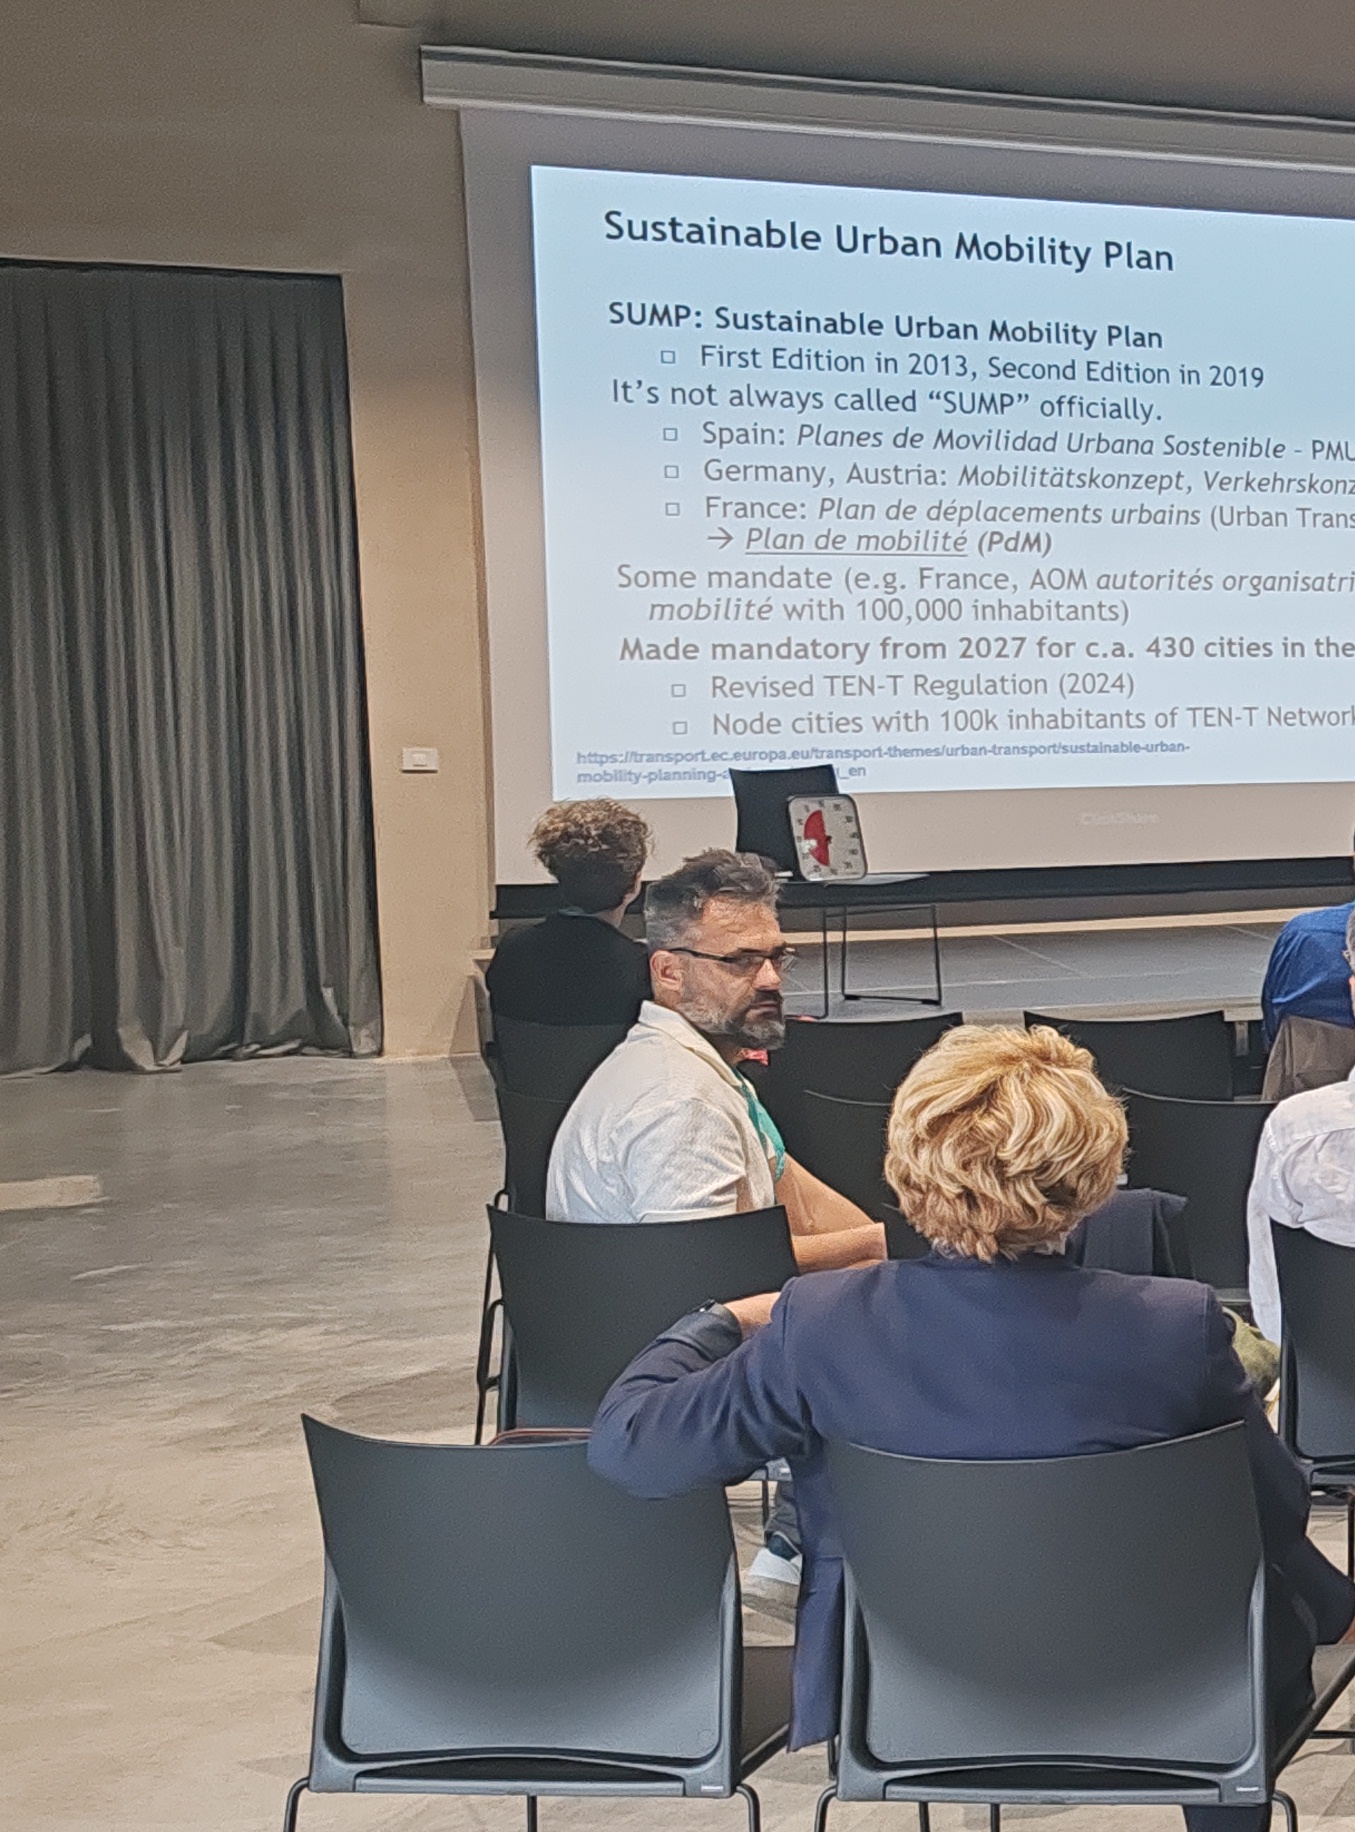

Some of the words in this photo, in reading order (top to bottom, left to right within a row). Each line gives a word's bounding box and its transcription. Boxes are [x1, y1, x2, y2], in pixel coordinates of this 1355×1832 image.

[604, 210, 822, 251] Sustainable
[836, 224, 942, 258] Urban
[955, 231, 1092, 274] Mobility
[1104, 240, 1174, 272] Plan
[608, 301, 702, 329] SUMP:
[714, 306, 884, 337] Sustainable
[895, 314, 979, 341] Urban
[988, 319, 1098, 351] Mobility
[1107, 324, 1163, 349] Plan
[701, 344, 763, 369] First
[772, 347, 865, 373] Edition
[874, 351, 898, 374] in
[908, 352, 977, 382] 2013,
[988, 356, 1076, 381] Second
[1086, 360, 1170, 384] Edition
[1178, 361, 1201, 385] in
[1209, 365, 1264, 389] 2019
[671, 383, 719, 407] not
[728, 383, 824, 415] always
[833, 387, 917, 413] called
[1039, 394, 1162, 426] officially.
[702, 420, 785, 450] Spain:
[797, 423, 884, 448] Planes
[892, 426, 925, 449] de
[932, 428, 1058, 453] Movilidad
[1066, 432, 1154, 456] Urbana
[1162, 434, 1286, 459] Sostenible
[703, 458, 835, 489] Germany,
[845, 462, 947, 487] Austria:
[957, 464, 1192, 496] Mobilitätskonzept,
[705, 495, 807, 520] France:
[818, 496, 876, 521] Plan
[885, 498, 918, 521] de
[926, 498, 1103, 528] déplacements
[1111, 502, 1201, 526] urbains
[1210, 505, 1288, 532] (Urban
[745, 527, 804, 551] Plan
[814, 529, 847, 551] de
[856, 529, 968, 552] mobilité
[977, 530, 1053, 559] (PdM)
[617, 563, 697, 589] Some
[707, 564, 833, 590] mandate
[844, 566, 907, 596] (e.g.
[918, 566, 1018, 595] France,
[1029, 567, 1088, 591] AOM
[1096, 567, 1214, 591] autorités
[648, 596, 774, 621] mobilité
[782, 597, 845, 622] with
[856, 597, 963, 626] 100,000
[971, 598, 1129, 627] inhabitants)
[619, 636, 700, 661] Made
[711, 636, 871, 666] mandatory
[879, 635, 947, 660] from
[958, 636, 1028, 659] 2027
[1035, 635, 1077, 659] for
[1085, 641, 1135, 659] c.a.
[1145, 636, 1195, 658] 430
[1203, 635, 1274, 658] cities
[1281, 636, 1306, 658] in
[711, 673, 814, 699] Revised
[822, 674, 904, 697] TEN-T
[913, 672, 1048, 701] Regulation
[1058, 672, 1135, 700] (2024)
[713, 711, 782, 736] Node
[791, 711, 864, 735] cities
[871, 709, 929, 733] with
[940, 708, 999, 732] 100k
[1007, 707, 1146, 731] inhabitants
[1154, 706, 1179, 729] of
[1185, 706, 1260, 728] TEN-T
